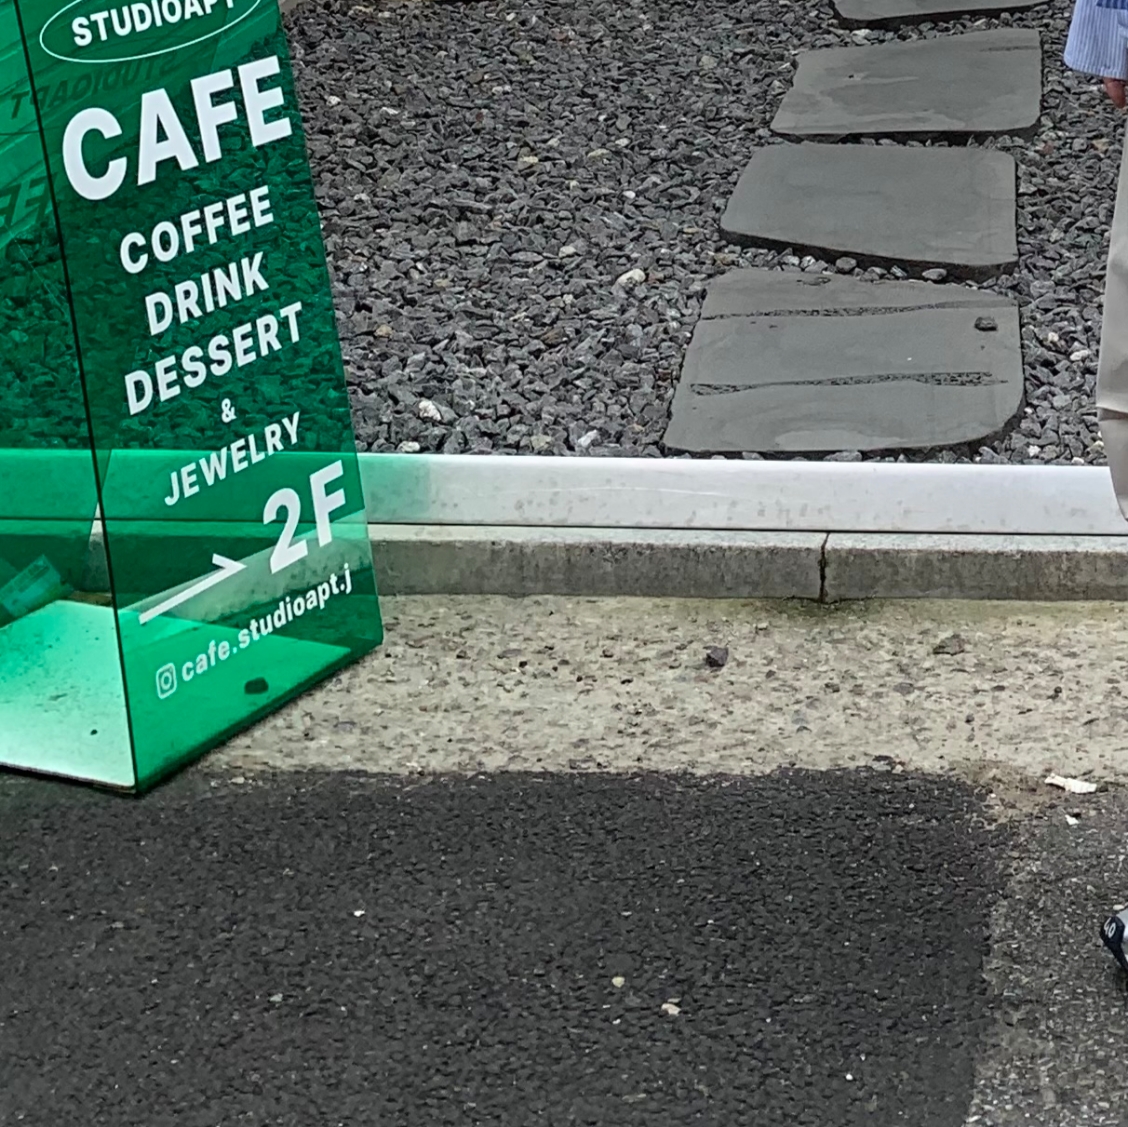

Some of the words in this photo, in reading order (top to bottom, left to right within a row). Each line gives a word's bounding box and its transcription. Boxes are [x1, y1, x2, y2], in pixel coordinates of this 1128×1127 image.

[62, 54, 293, 201] CAFE
[119, 185, 275, 274] COFFEE
[145, 251, 270, 336] DRINK
[124, 301, 303, 416] DESSERT
[221, 398, 237, 423] &
[164, 411, 300, 507] JEWELRY
[263, 460, 346, 575] 2F
[181, 563, 352, 682] cafe.studioapt.j
